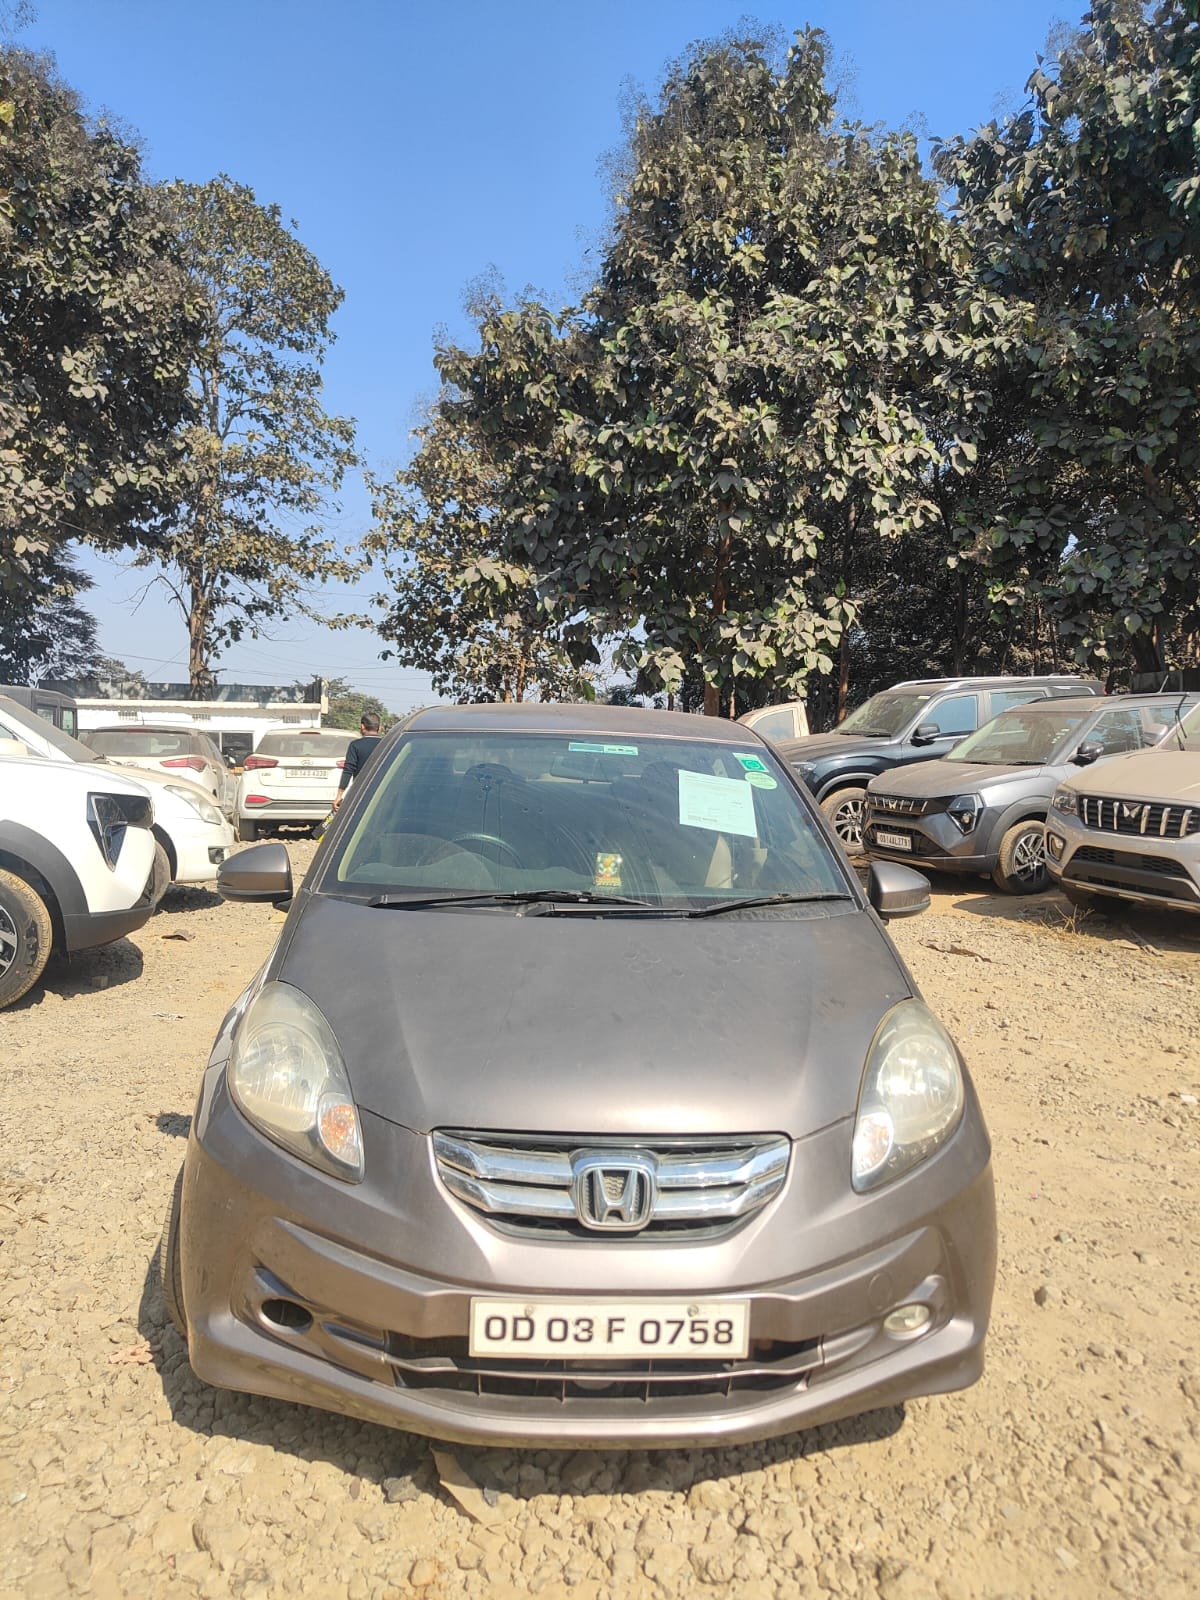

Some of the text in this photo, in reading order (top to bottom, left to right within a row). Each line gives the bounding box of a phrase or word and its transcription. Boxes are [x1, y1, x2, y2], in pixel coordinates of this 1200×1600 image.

[485, 1316, 734, 1345] OD 03 F 0758
